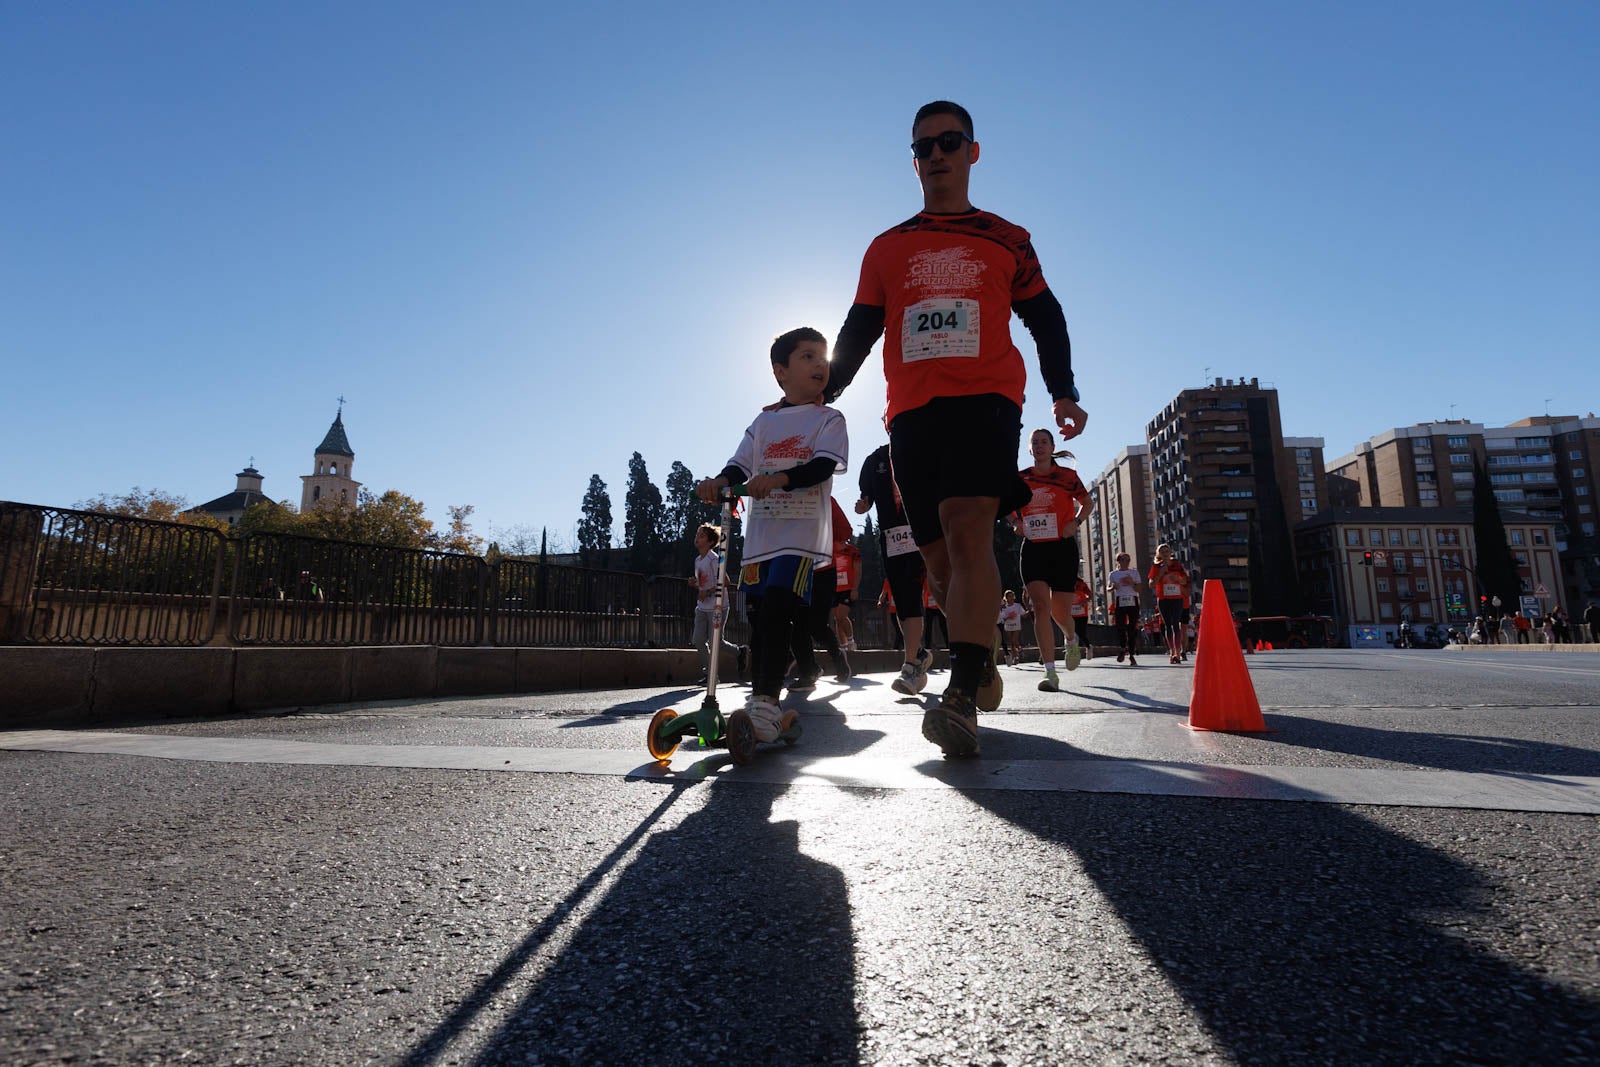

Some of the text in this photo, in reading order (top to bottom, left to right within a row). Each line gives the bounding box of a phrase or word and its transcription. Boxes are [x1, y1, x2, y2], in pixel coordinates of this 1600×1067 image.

[911, 262, 979, 275] carrera
[917, 311, 958, 332] 204
[1029, 519, 1047, 528] 904
[1453, 594, 1460, 602] P
